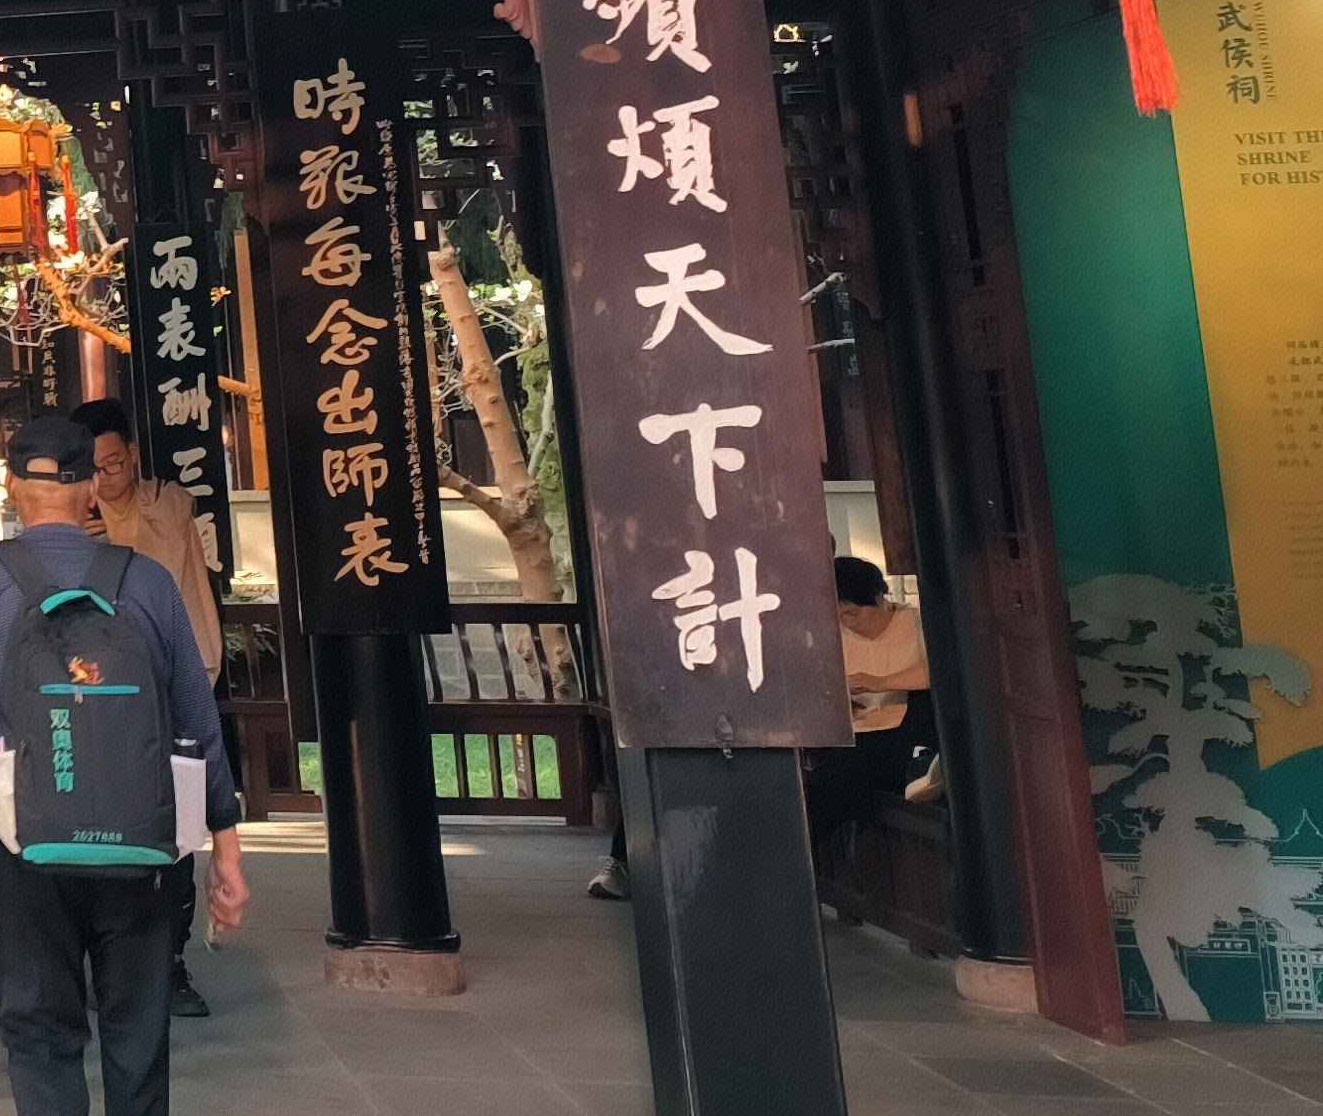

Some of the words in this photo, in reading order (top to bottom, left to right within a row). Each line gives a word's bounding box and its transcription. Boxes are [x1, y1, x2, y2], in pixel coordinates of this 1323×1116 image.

[1254, 2, 1269, 48] WUHOU
[1216, 1, 1260, 104] 武侯祠
[1261, 54, 1278, 102] SHRINE
[1234, 131, 1286, 145] VISIT
[1293, 130, 1323, 144] TH
[1237, 151, 1311, 165] SHRINE
[1240, 172, 1281, 185] FOR
[1286, 170, 1323, 184] HIS
